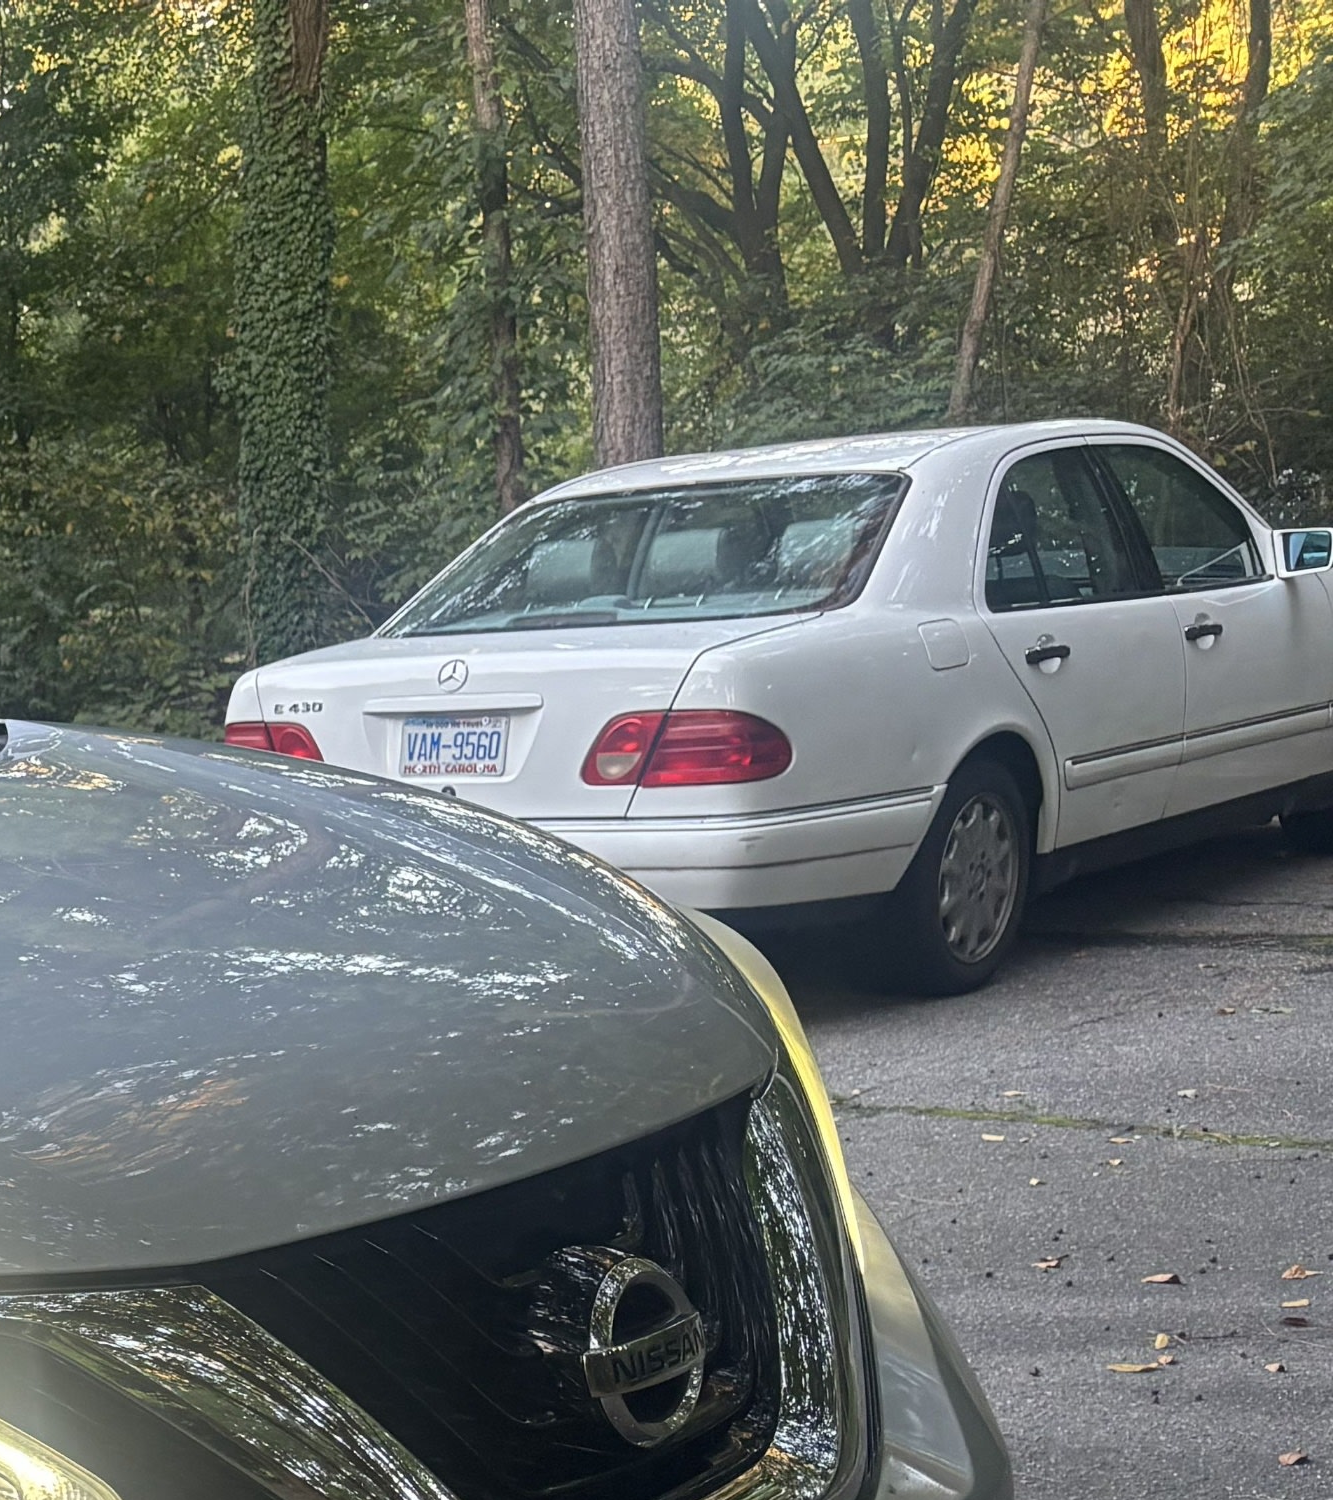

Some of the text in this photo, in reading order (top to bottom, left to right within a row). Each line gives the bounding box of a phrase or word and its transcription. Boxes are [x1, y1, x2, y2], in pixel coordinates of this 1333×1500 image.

[274, 702, 323, 714] E 430
[407, 730, 502, 762] VAM-9560
[445, 763, 498, 774] CAROLNA
[613, 1324, 701, 1383] NISSAN
